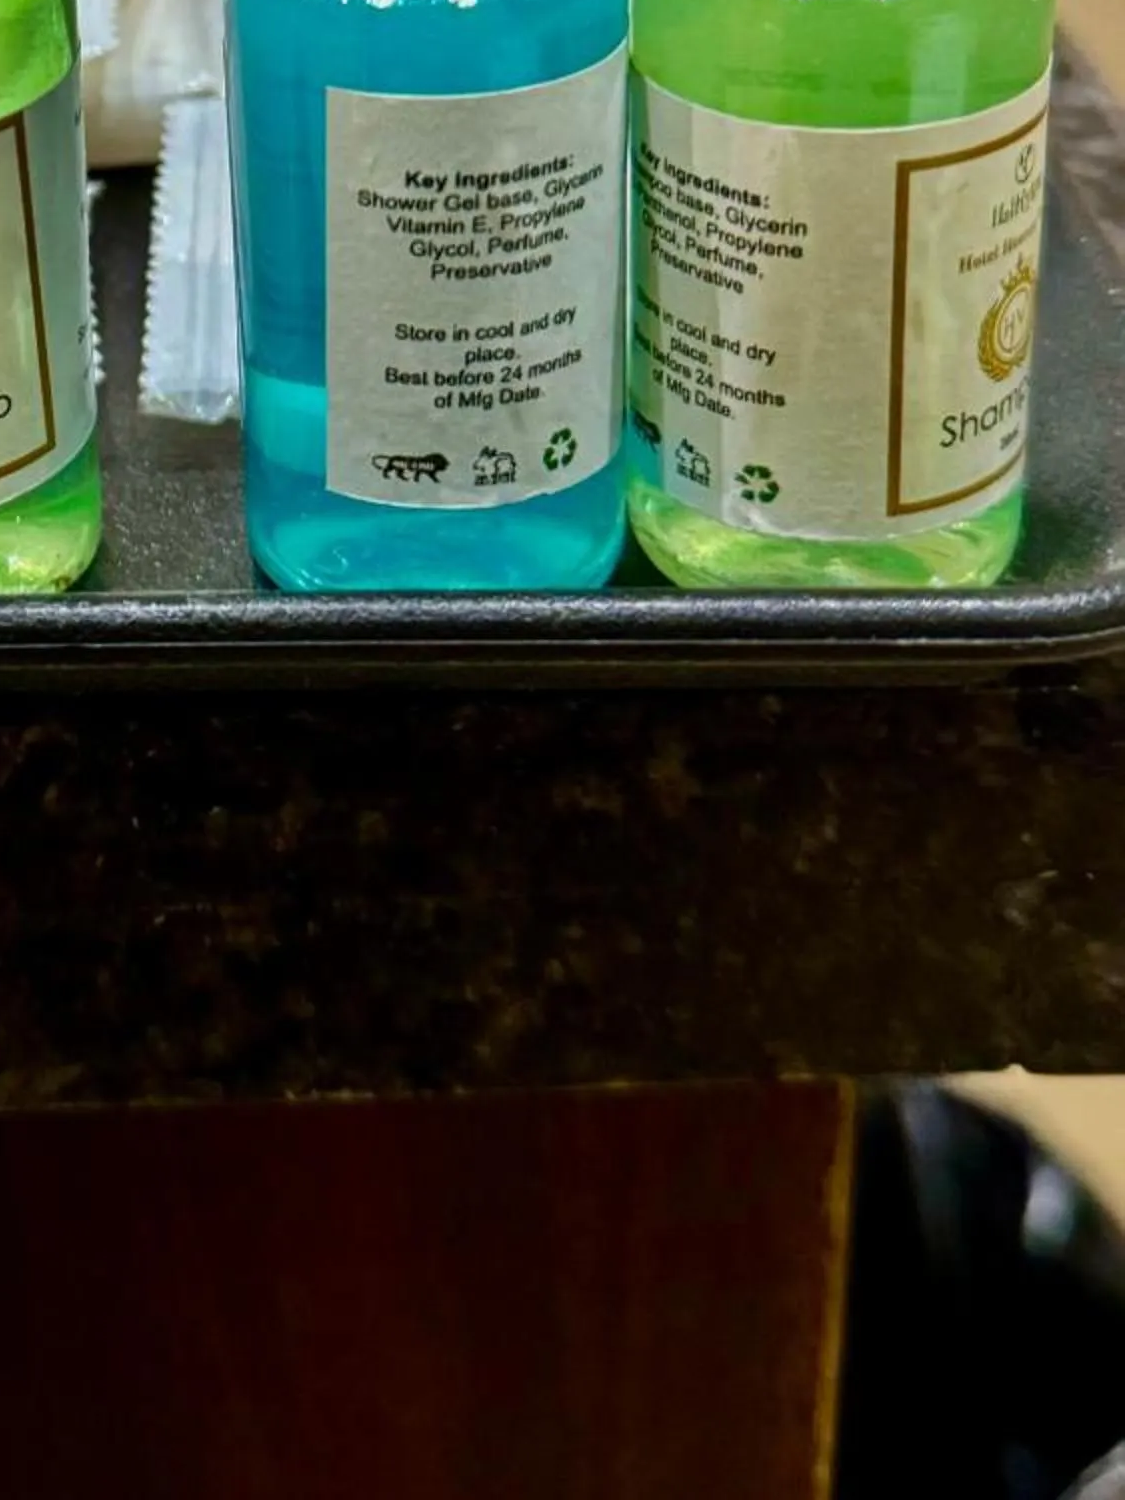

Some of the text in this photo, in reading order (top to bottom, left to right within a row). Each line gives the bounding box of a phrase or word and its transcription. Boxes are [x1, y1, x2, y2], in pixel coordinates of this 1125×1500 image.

[404, 153, 574, 193] Key Ingredients:
[663, 156, 770, 209] Ingredients:
[357, 187, 437, 213] Shower
[443, 192, 480, 213] Gel
[486, 188, 539, 211] base,
[386, 214, 465, 235] Vitamin
[500, 195, 586, 230] Propylene
[675, 187, 807, 237] base, Glycerin
[409, 227, 569, 261] Glycol, Perfume,
[685, 234, 764, 281] Perfume,
[705, 220, 804, 260] Propylene
[430, 253, 552, 281] Preservative
[650, 238, 744, 295] Preservative
[394, 306, 576, 342] Store in cool and dry
[663, 308, 674, 327] in
[676, 319, 707, 342] cool
[711, 332, 740, 356] and
[746, 343, 777, 366] dry
[384, 348, 582, 387] Best before 24 months
[670, 336, 713, 367] place.
[433, 391, 453, 409] of
[458, 389, 494, 411] Mfg
[666, 374, 691, 405] Mfg
[695, 367, 715, 389] 24
[719, 380, 786, 407] months
